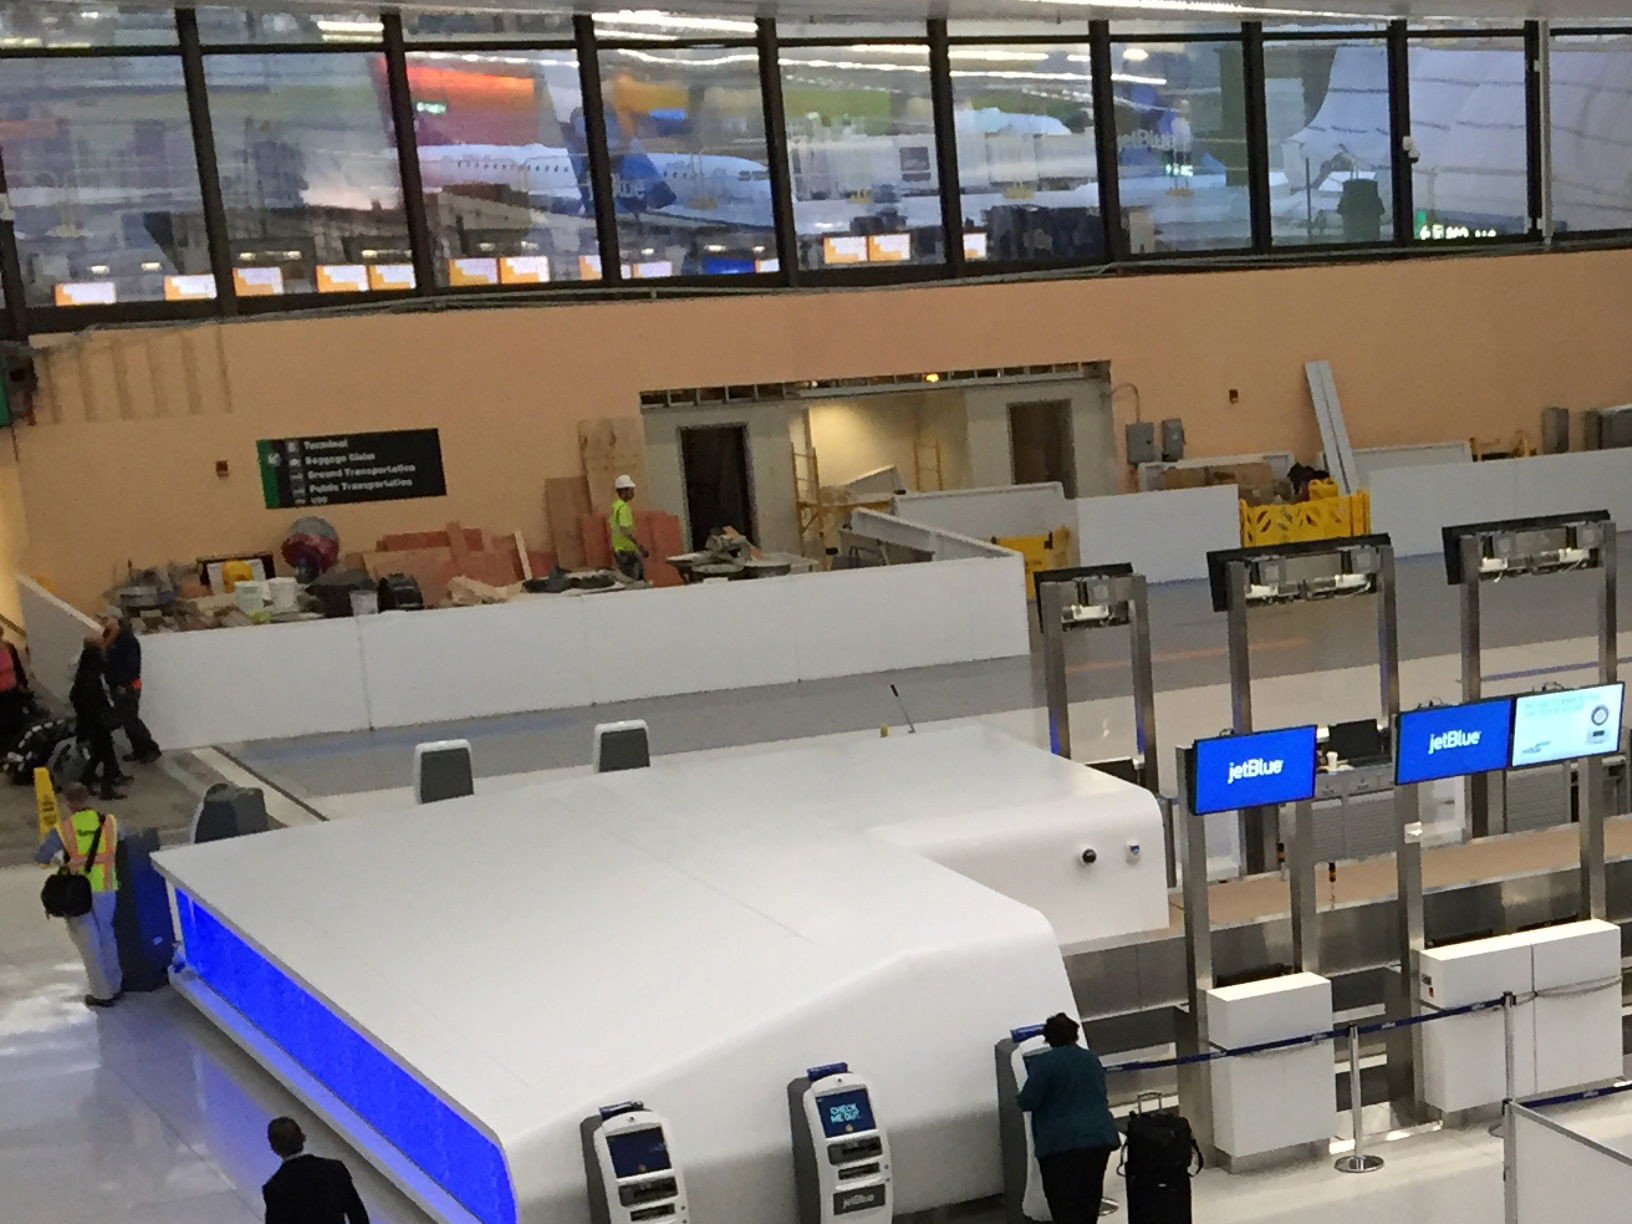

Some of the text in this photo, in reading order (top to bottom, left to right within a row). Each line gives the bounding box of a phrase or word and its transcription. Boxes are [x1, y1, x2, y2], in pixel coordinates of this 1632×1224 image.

[344, 464, 416, 476] Transportation
[341, 479, 413, 490] Transportation
[1428, 729, 1481, 755] jetBlue
[1228, 757, 1284, 784] jetBlue
